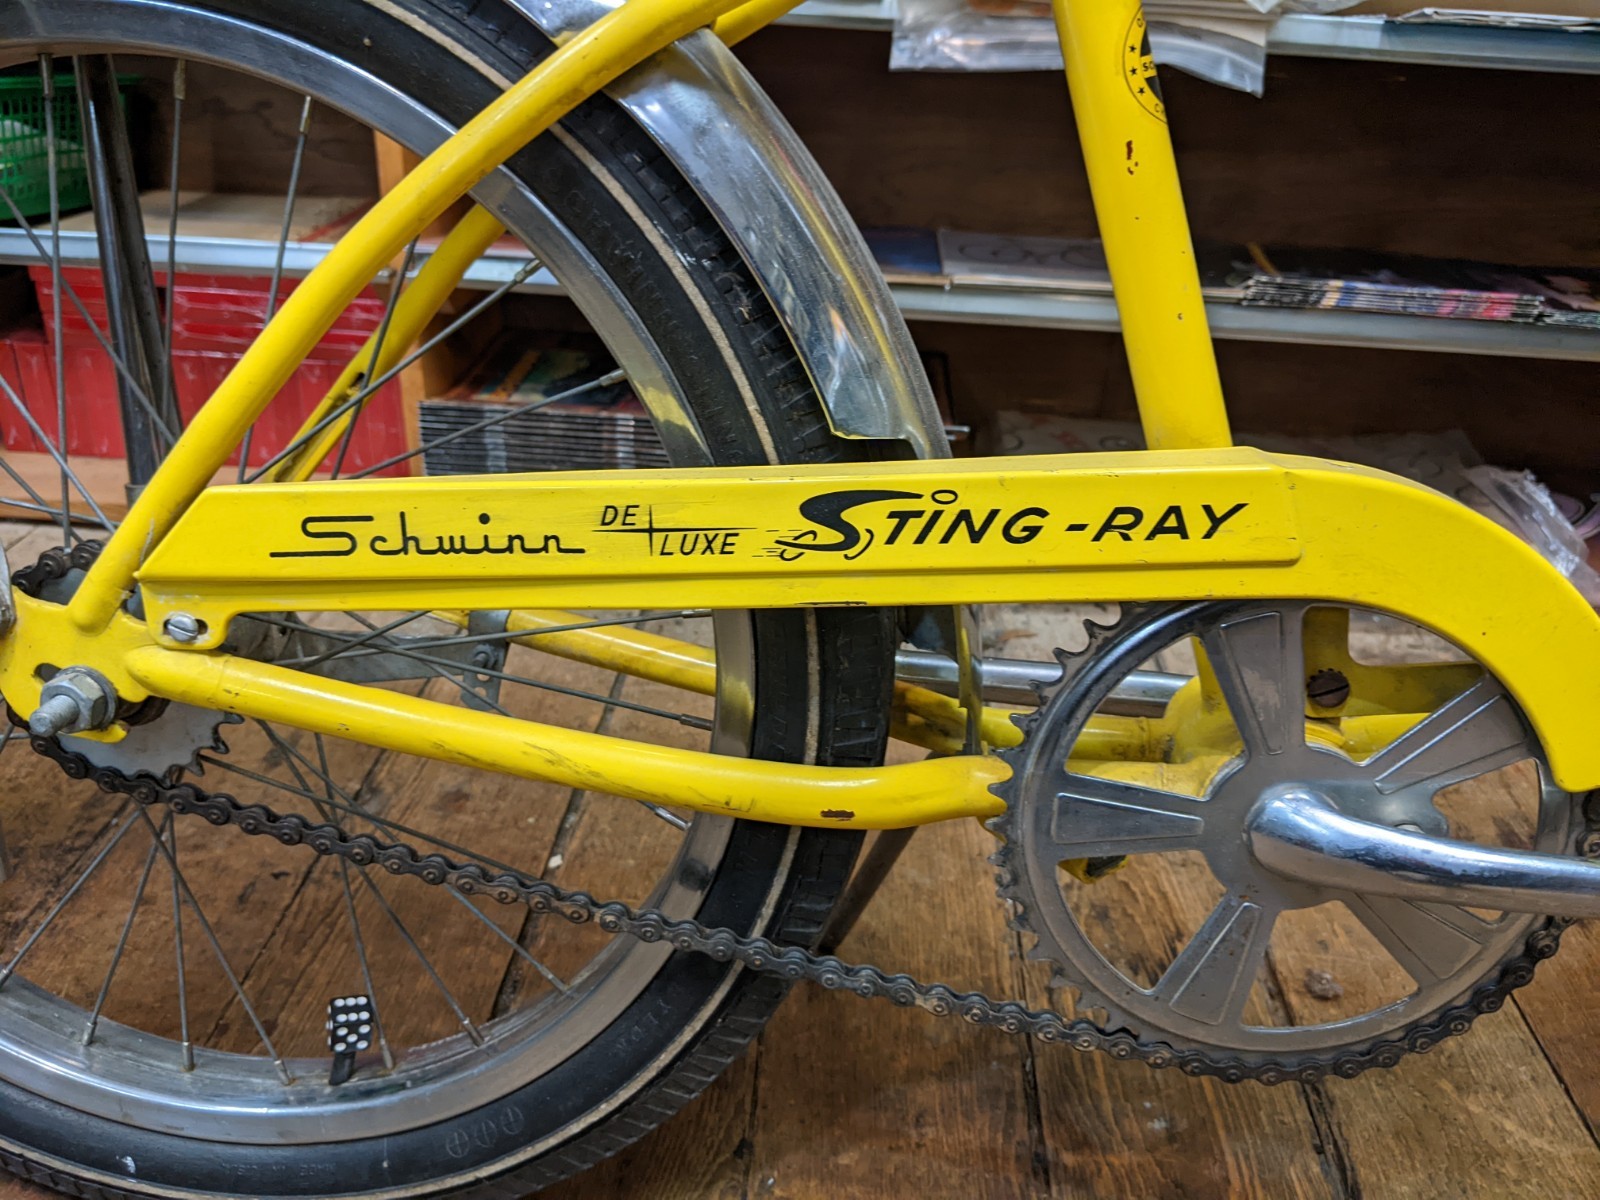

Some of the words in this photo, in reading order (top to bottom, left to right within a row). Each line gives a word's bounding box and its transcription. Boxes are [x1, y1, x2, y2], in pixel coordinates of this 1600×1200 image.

[600, 504, 640, 527] DE
[269, 511, 586, 558] Schwinn
[659, 532, 740, 557] LUXE
